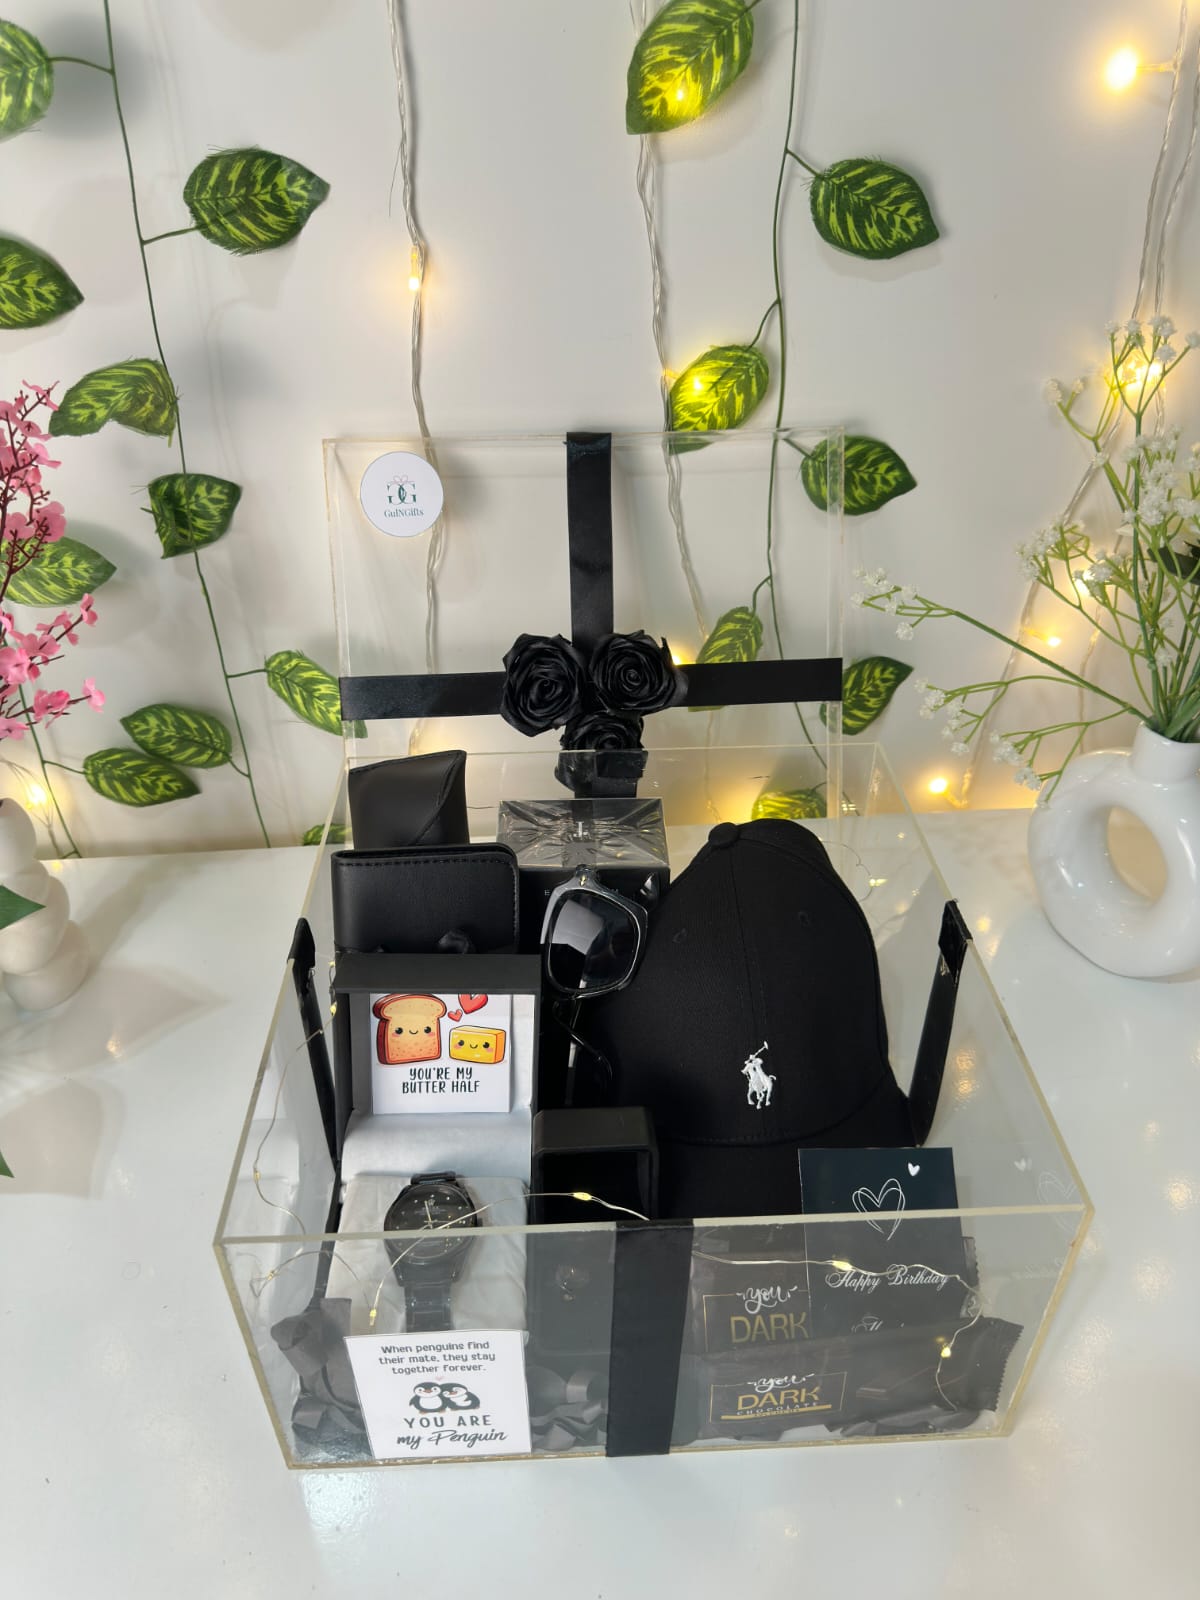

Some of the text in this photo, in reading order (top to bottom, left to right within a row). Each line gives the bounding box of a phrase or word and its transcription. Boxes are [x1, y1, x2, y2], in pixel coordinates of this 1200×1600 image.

[409, 1066, 473, 1081] YOU'RE MY
[402, 1080, 480, 1094] BUTTER HALF
[825, 1263, 949, 1294] Happy Birthday
[730, 1311, 810, 1344] DARK
[381, 1341, 490, 1354] When penguins find
[379, 1355, 405, 1365] their
[443, 1353, 468, 1362] they
[471, 1352, 496, 1361] stay
[392, 1364, 486, 1375] together forever.
[737, 1385, 820, 1411] DARK
[736, 1402, 818, 1416] CHOCOLATE
[404, 1414, 493, 1429] YOU ARE
[396, 1428, 509, 1449] my Penguin
